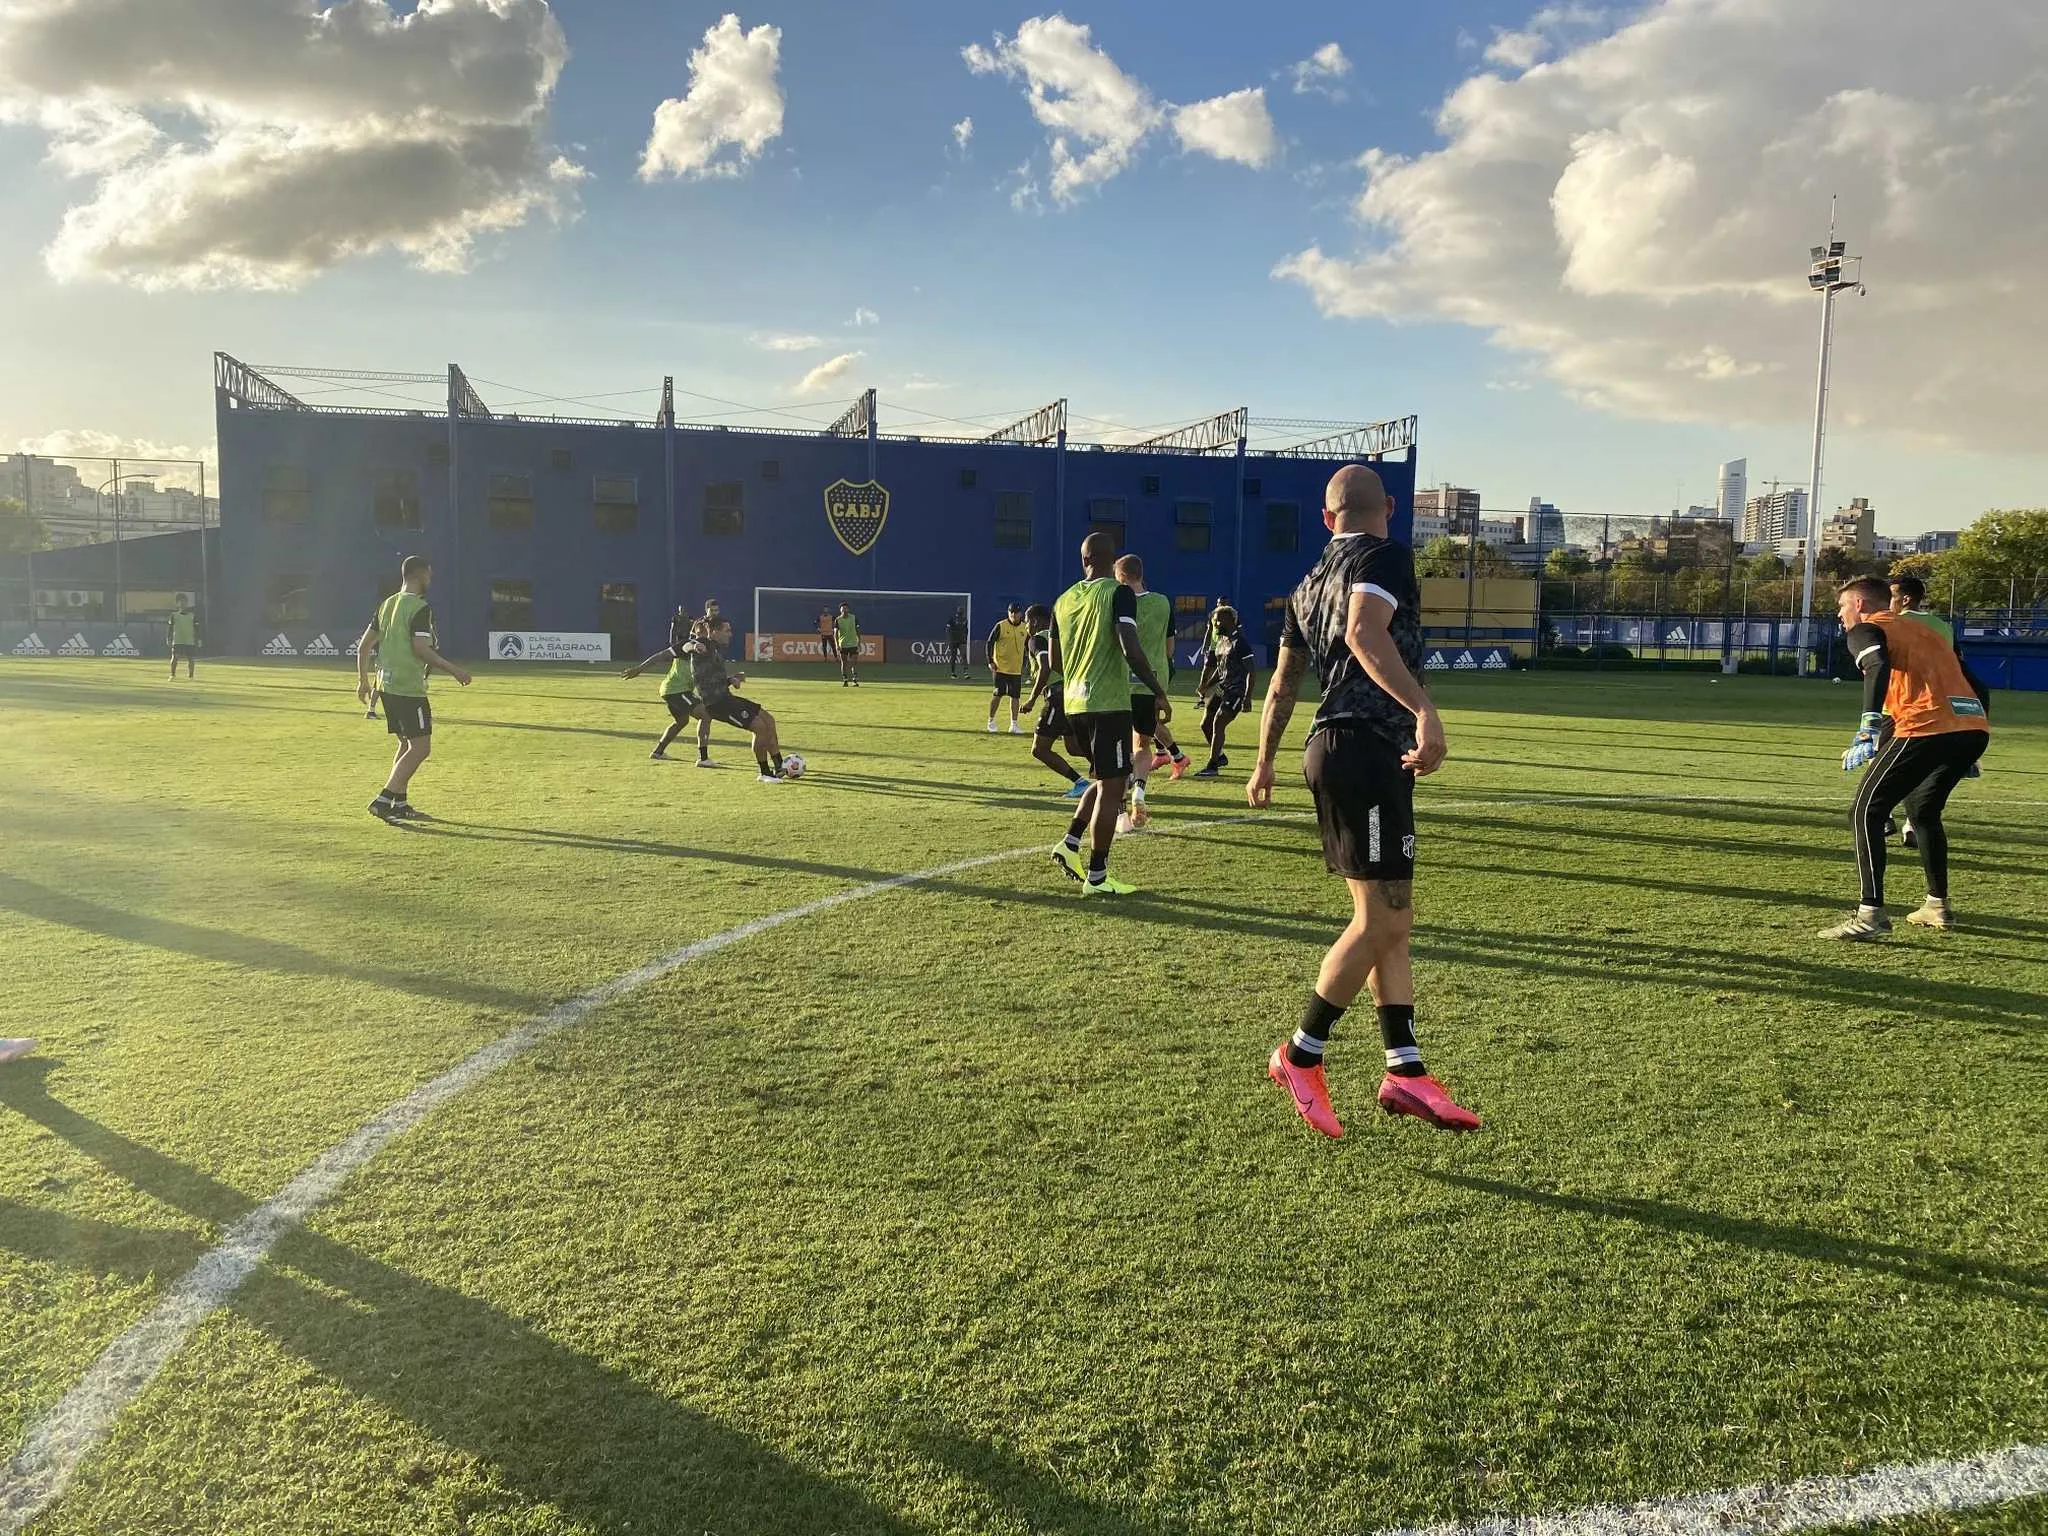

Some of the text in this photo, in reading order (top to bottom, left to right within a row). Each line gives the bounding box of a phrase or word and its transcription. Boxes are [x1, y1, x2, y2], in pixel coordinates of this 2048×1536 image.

[833, 503, 881, 518] CABJ
[547, 643, 602, 651] SAGRADA
[57, 648, 96, 656] adidas
[102, 648, 140, 656] adidas
[262, 648, 298, 656] adidas
[304, 648, 340, 656] adidas
